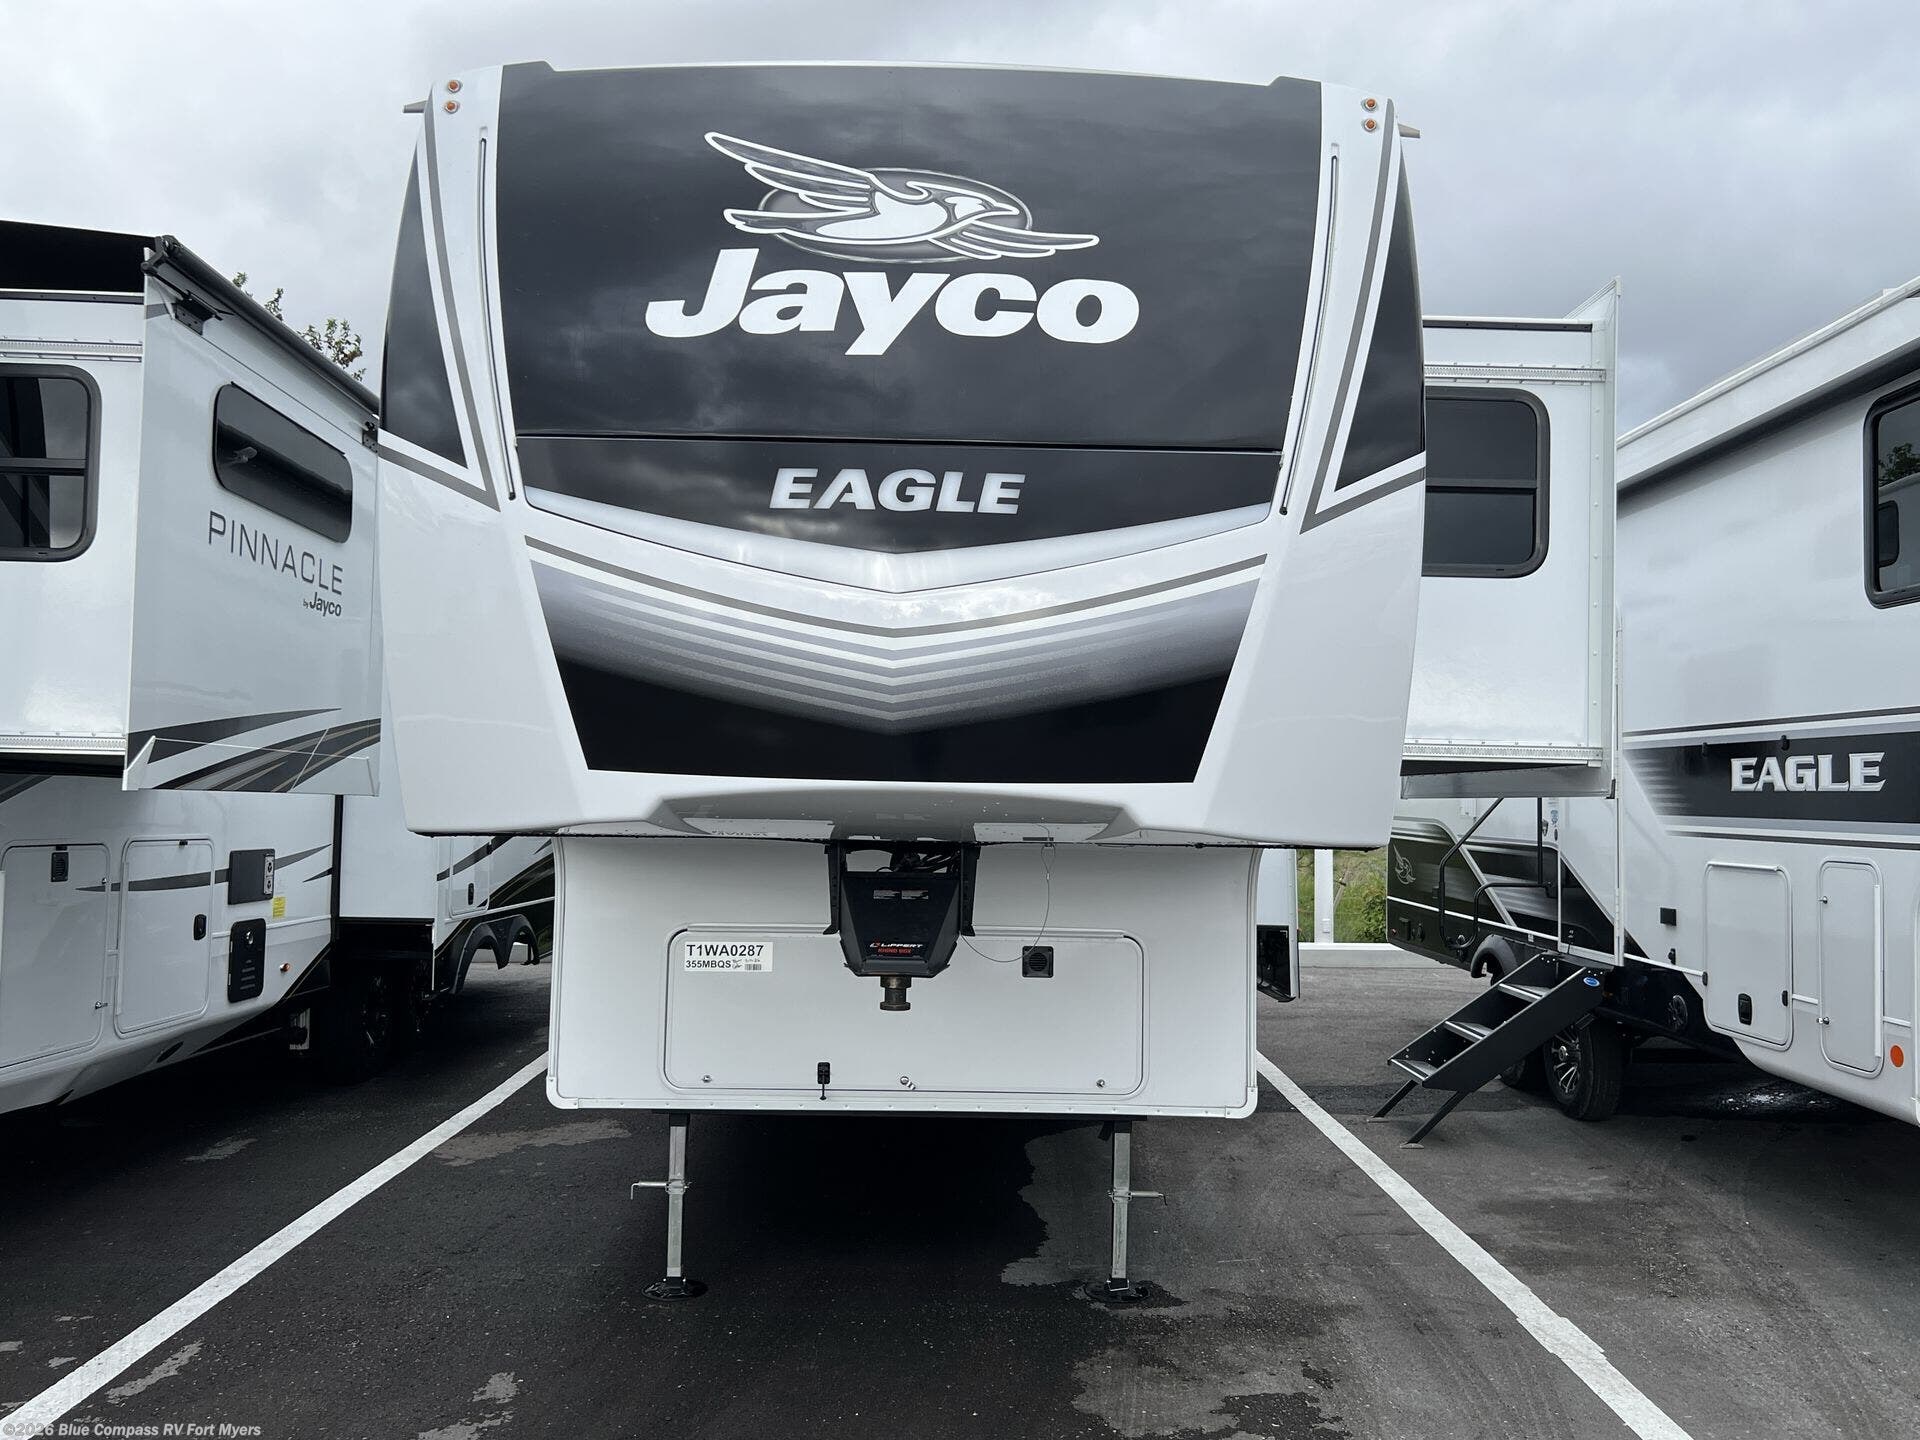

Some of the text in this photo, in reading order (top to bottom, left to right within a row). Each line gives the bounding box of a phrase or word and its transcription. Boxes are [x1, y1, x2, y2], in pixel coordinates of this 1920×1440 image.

[645, 248, 1140, 356] Jayco
[769, 467, 1026, 515] EAGLE
[208, 510, 344, 595] PINNACLE
[309, 591, 342, 617] Jayco
[1730, 752, 1886, 792] EAGLE
[686, 944, 764, 957] T1WA0287
[686, 960, 732, 968] 355MBQS
